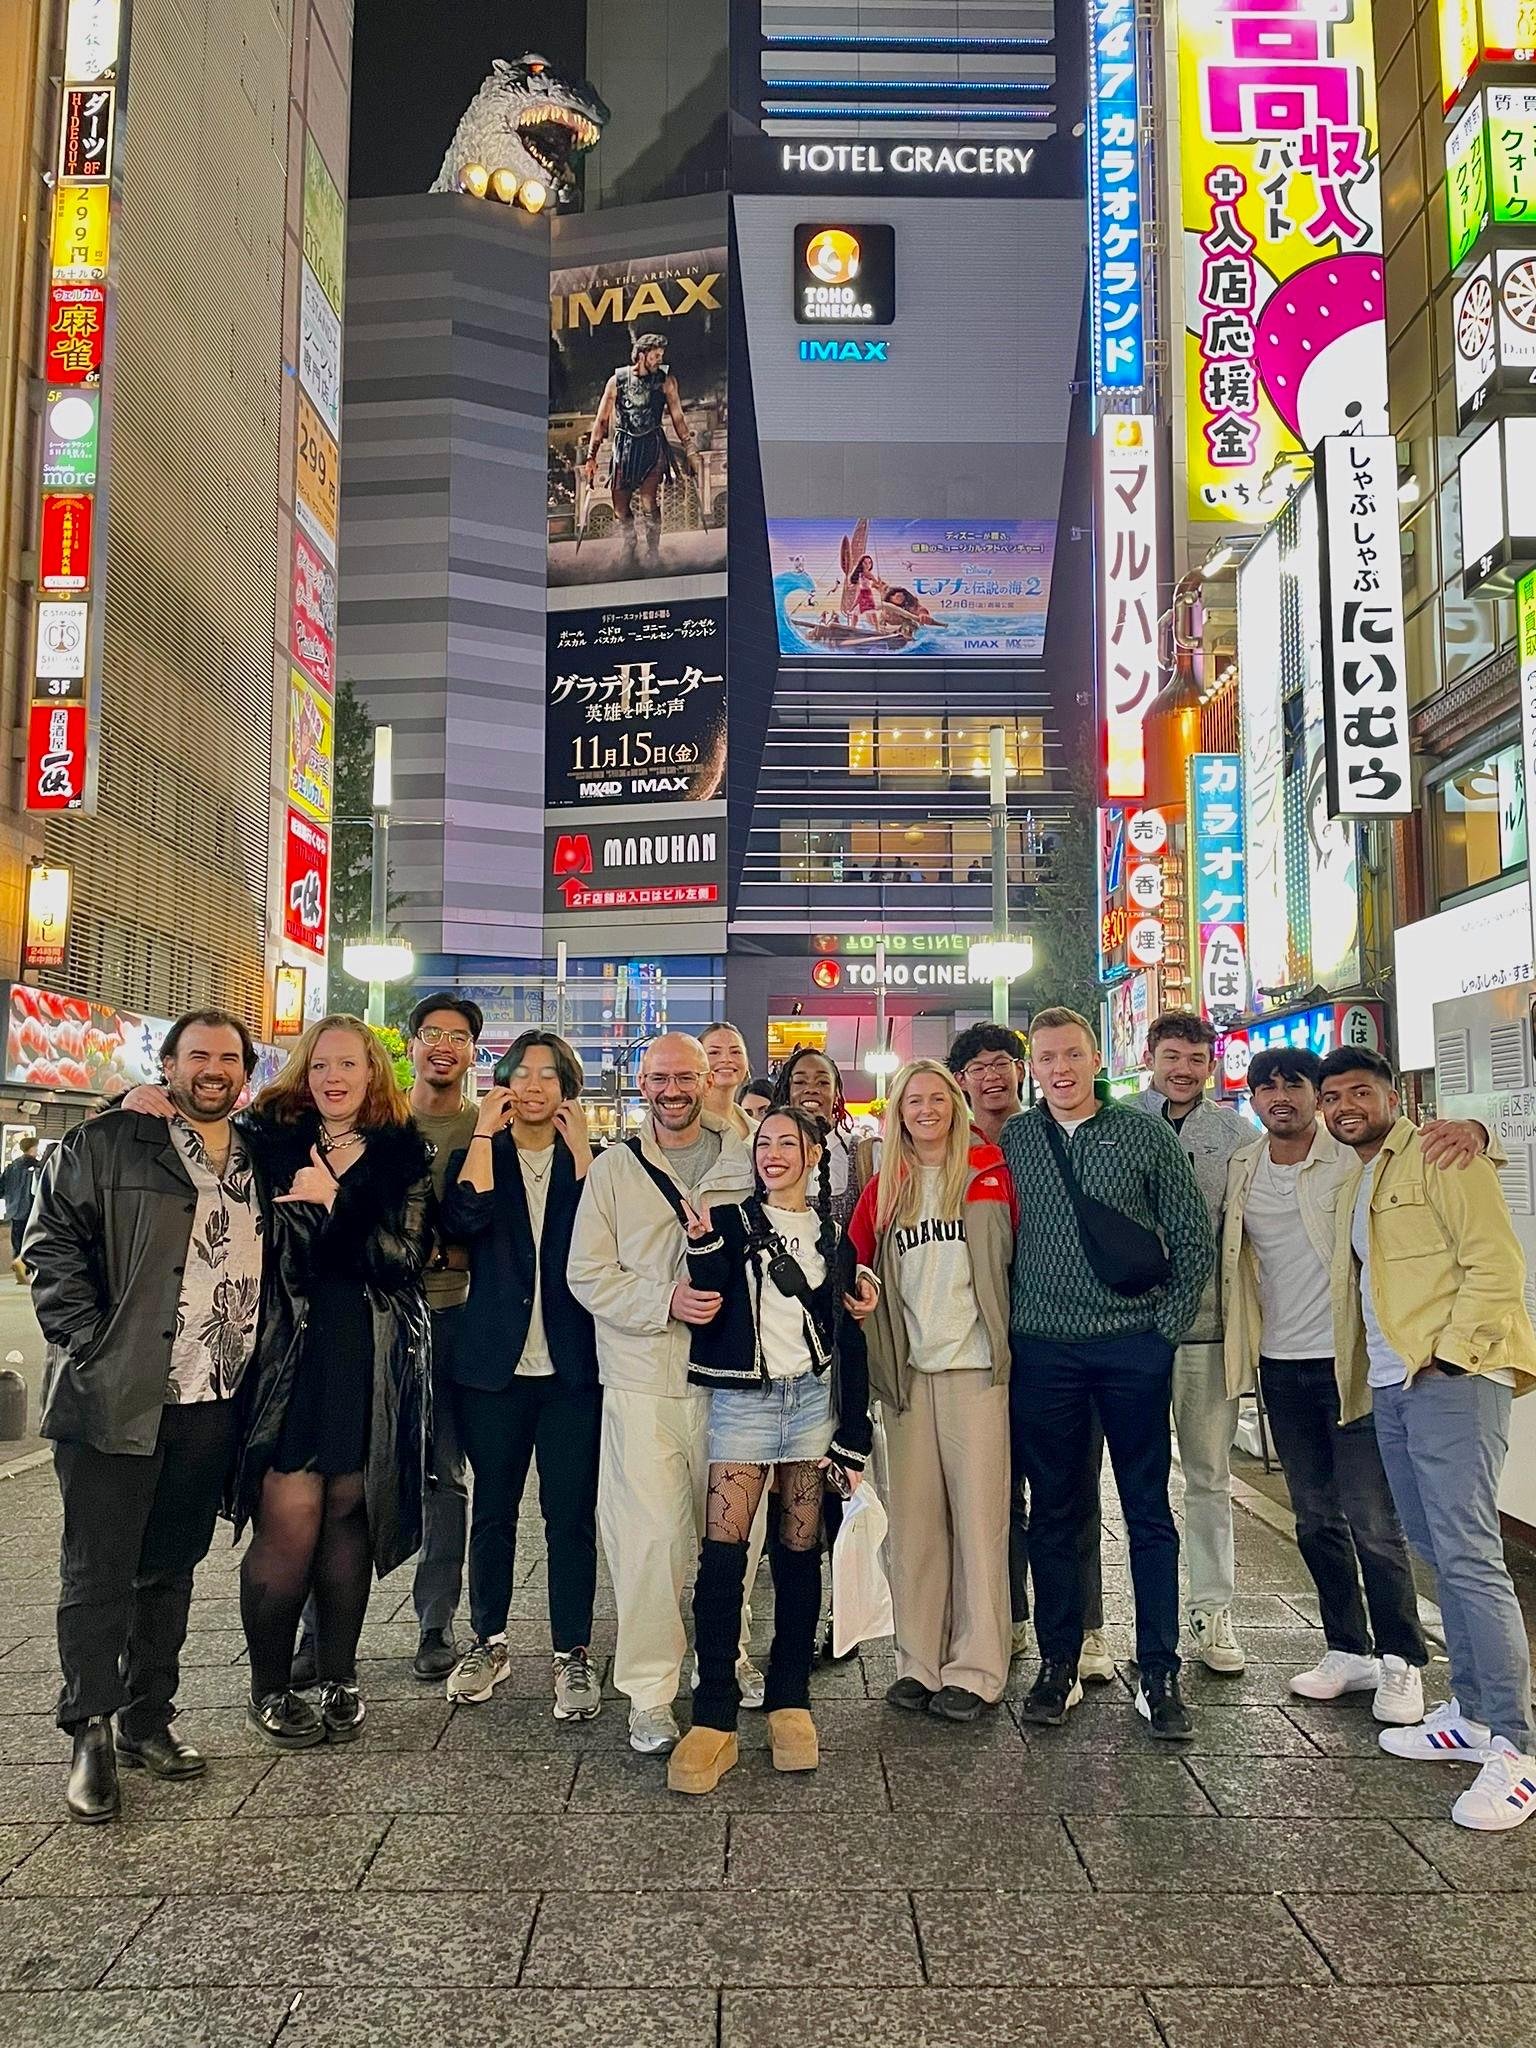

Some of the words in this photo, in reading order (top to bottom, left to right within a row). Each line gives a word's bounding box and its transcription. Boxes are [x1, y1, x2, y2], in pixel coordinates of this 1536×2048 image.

[68, 94, 82, 175] HIDEOUT
[82, 92, 110, 160] ダーツ
[83, 161, 100, 175] 8F
[783, 145, 884, 172] HOTEL
[890, 146, 1033, 174] GRACERY
[1501, 129, 1528, 218] クォーク
[1259, 141, 1297, 238] バイト
[615, 275, 637, 284] THE
[642, 270, 681, 281] ARENA
[686, 265, 700, 275] IN
[54, 289, 101, 302] ウェルカム
[551, 273, 722, 330] IMAX
[804, 287, 856, 304] TOHO
[805, 303, 873, 319] CINEMAS
[53, 304, 98, 370] 麻雀
[800, 341, 888, 361] IMAX
[86, 370, 100, 382] 6F
[47, 391, 62, 402] 5F
[43, 472, 96, 485] more
[1349, 446, 1380, 592] しゃぶしゃぶ
[1109, 463, 1151, 715] マルハン
[557, 639, 588, 649] メスカル
[635, 631, 674, 642] ニールセン
[681, 628, 717, 639] ワシントン
[643, 624, 667, 632] コニー
[682, 619, 715, 629] デンゼル
[964, 640, 999, 649] IMAX
[48, 679, 71, 695] 3F
[550, 665, 724, 706] グラディエーター
[585, 698, 686, 724] 英雄を呼ぶ声
[1342, 601, 1402, 800] にいむら
[52, 711, 66, 750] 居酒屋
[572, 731, 699, 770] 11月15日(金)
[580, 781, 622, 797] MX4D
[632, 776, 690, 794] IMAX
[603, 833, 717, 868] MARUHAN
[1200, 759, 1243, 923] カラオケ
[1209, 940, 1240, 1009] たば
